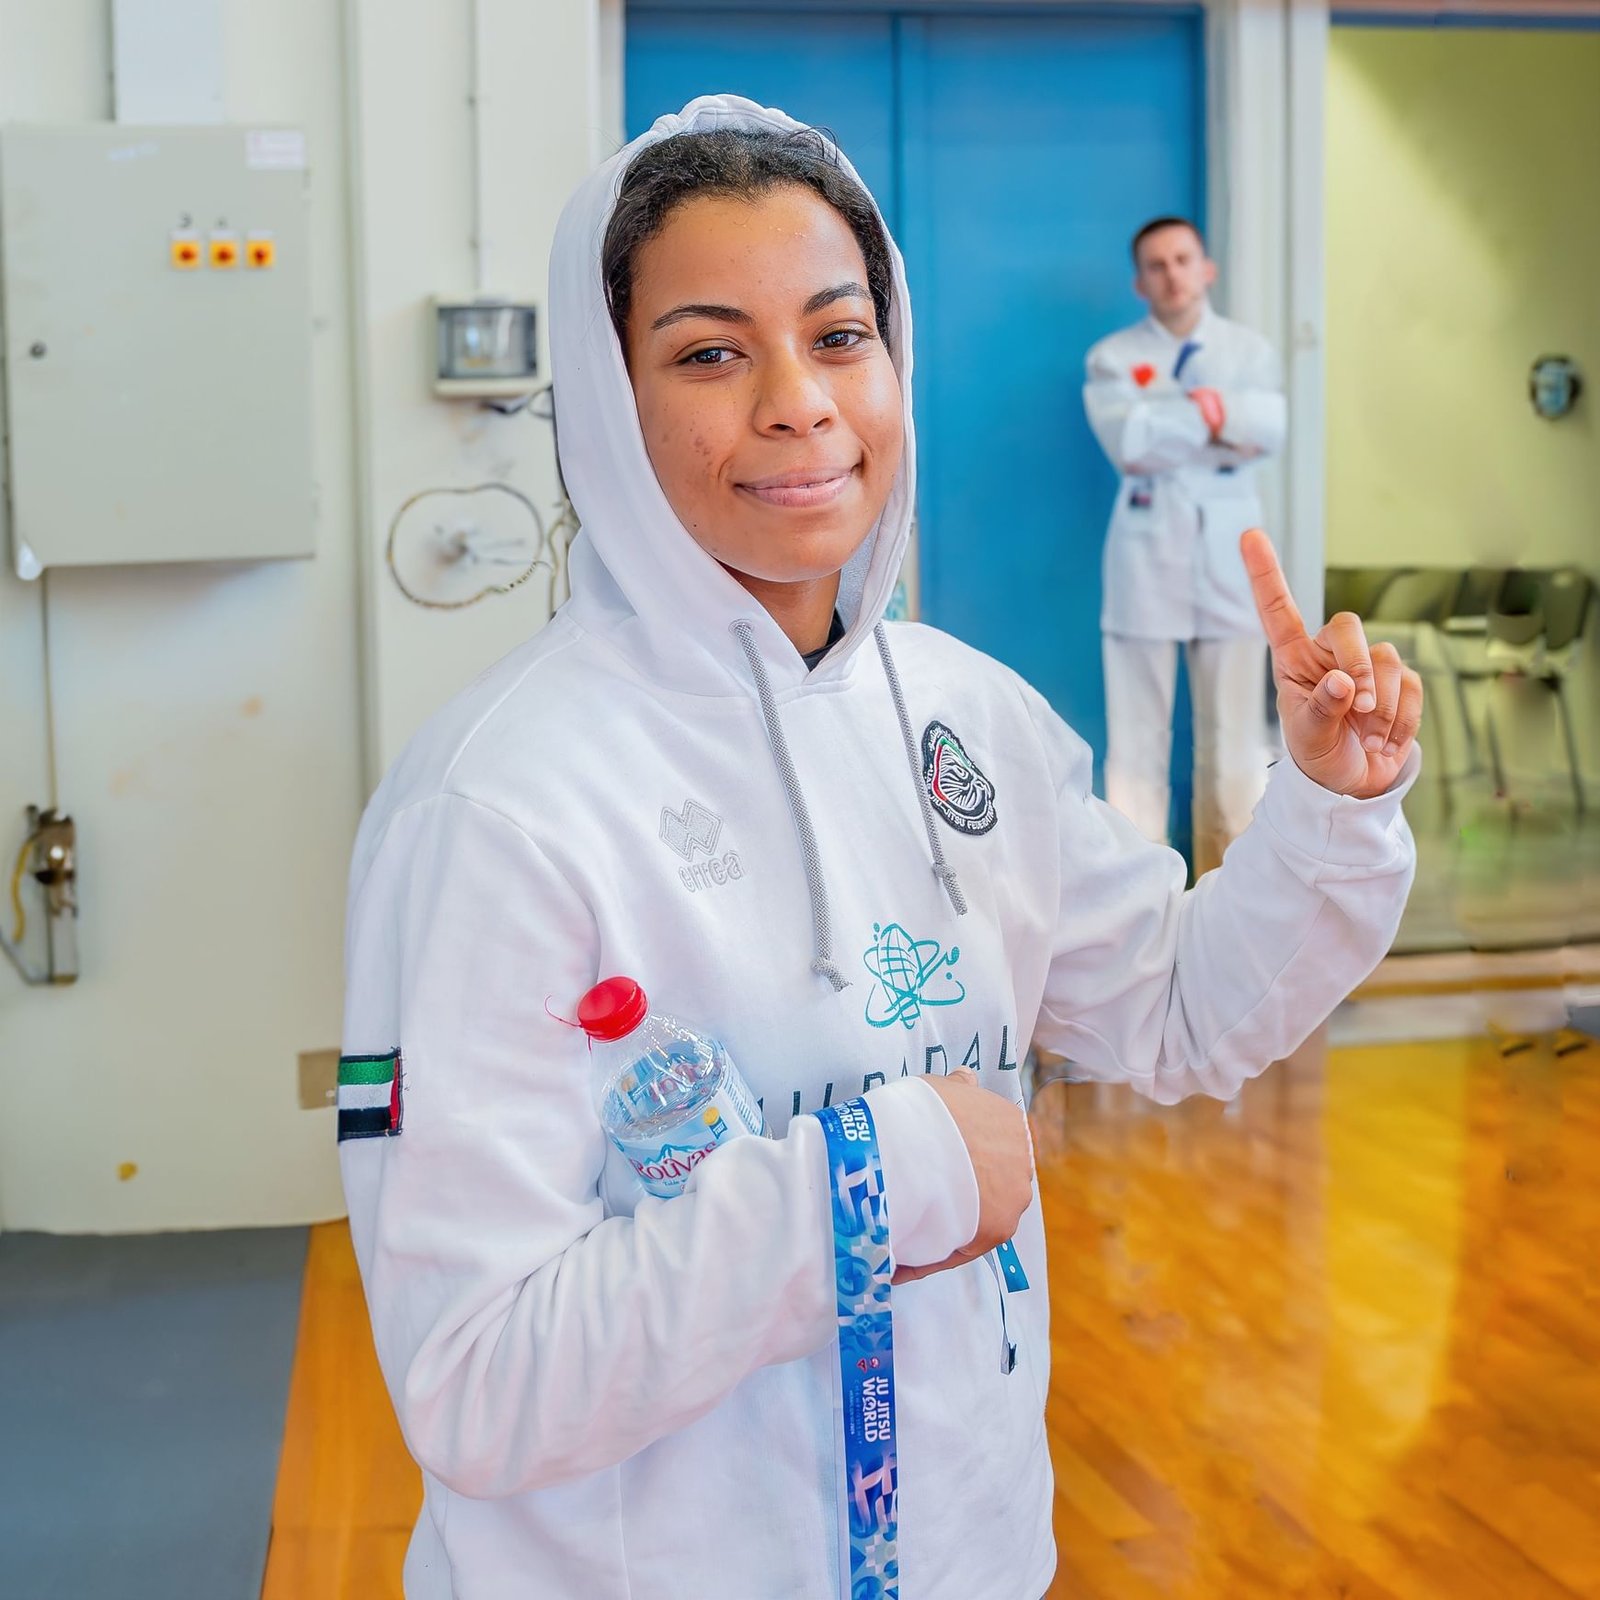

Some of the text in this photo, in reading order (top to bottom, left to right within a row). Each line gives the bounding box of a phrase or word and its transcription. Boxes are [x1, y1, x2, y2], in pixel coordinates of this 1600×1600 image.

[678, 849, 743, 893] errea
[832, 1103, 858, 1142] WORLD
[851, 1108, 872, 1142] JITSU
[862, 1376, 878, 1442] WORLD
[876, 1376, 891, 1440] JU JITSU
